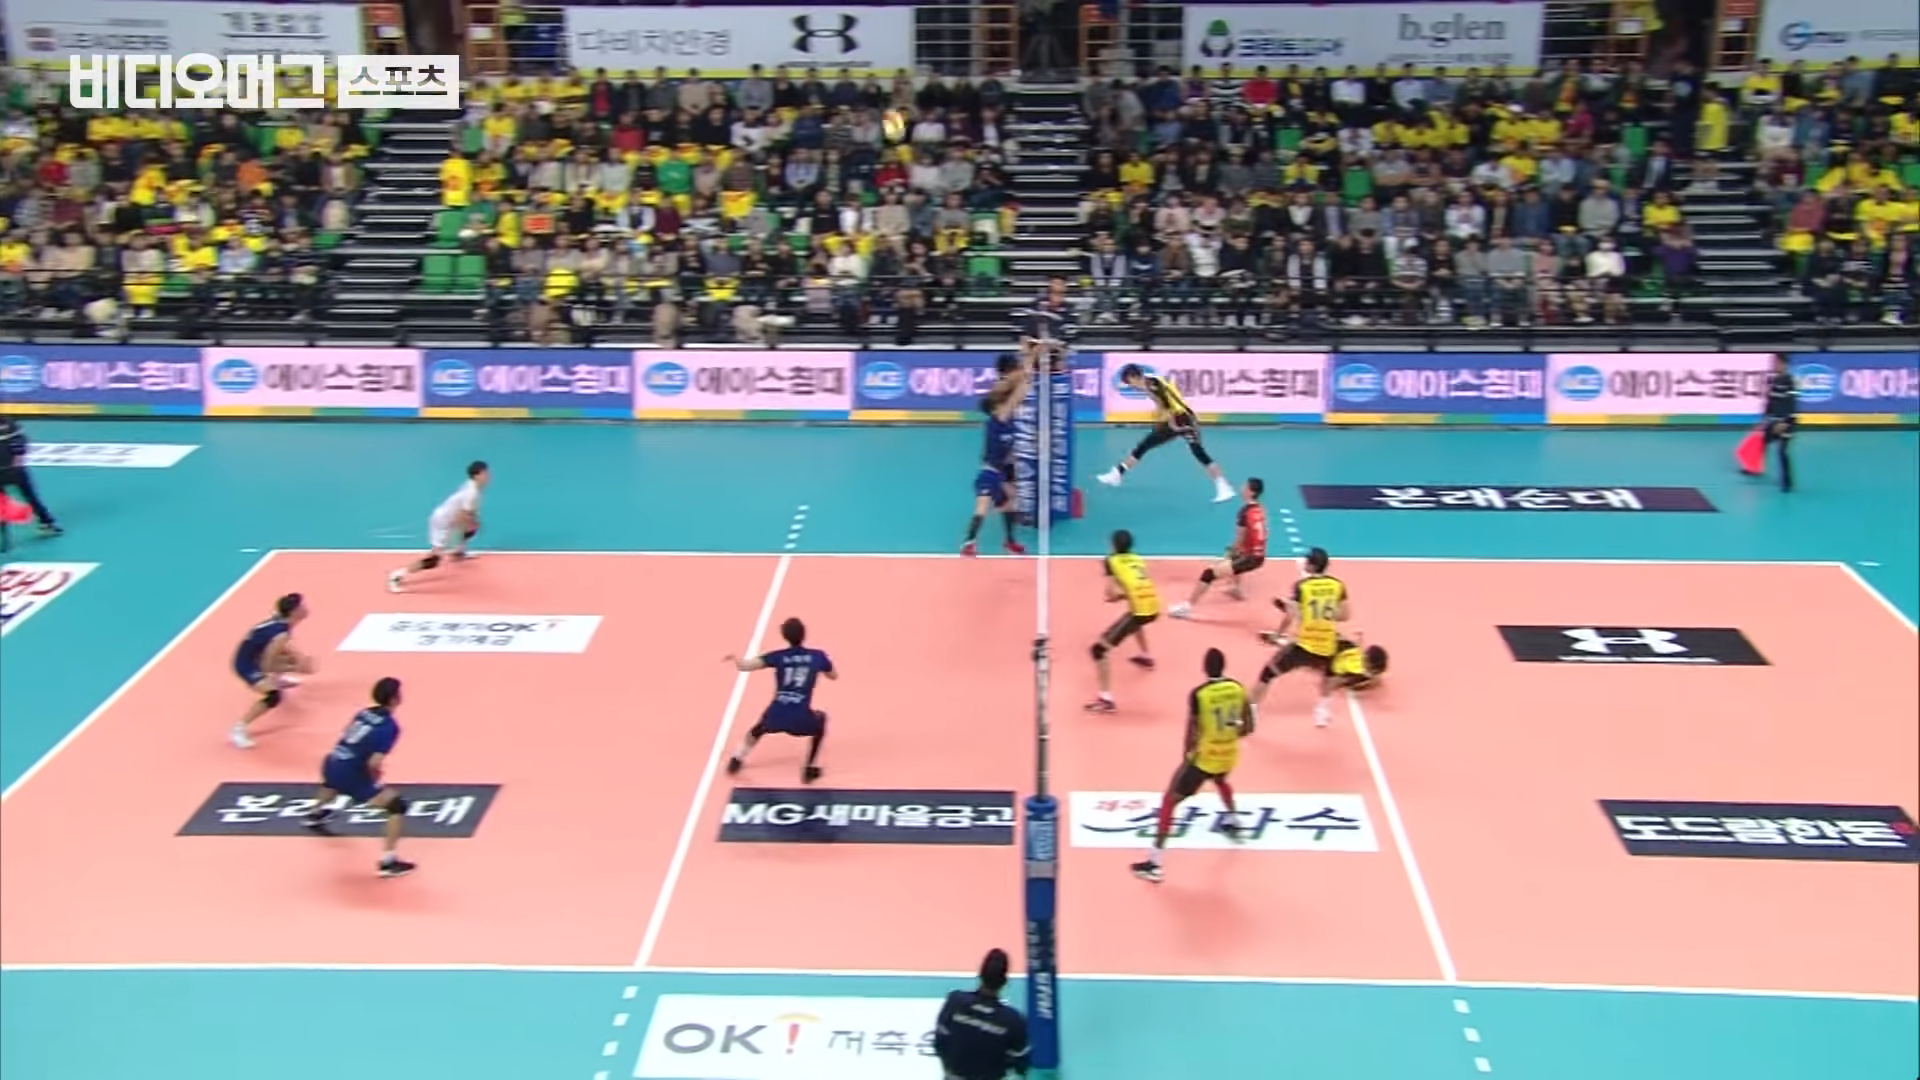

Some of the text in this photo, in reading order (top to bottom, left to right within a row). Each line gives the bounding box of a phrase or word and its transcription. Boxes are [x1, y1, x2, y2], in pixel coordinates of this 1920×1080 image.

[577, 28, 732, 56] 다비치안경
[1398, 13, 1506, 47] b.glen
[43, 361, 200, 391] 에이스침대
[265, 364, 415, 392] 에이스침대
[478, 364, 631, 394] 에이스침대
[695, 366, 845, 395] 에이스침대
[1384, 369, 1543, 399] 에이스침대
[1369, 487, 1645, 511] 본래순대
[1310, 599, 1335, 621] 16
[721, 803, 1017, 829] MG새마을금고
[1614, 814, 1908, 848] 도드람한돈
